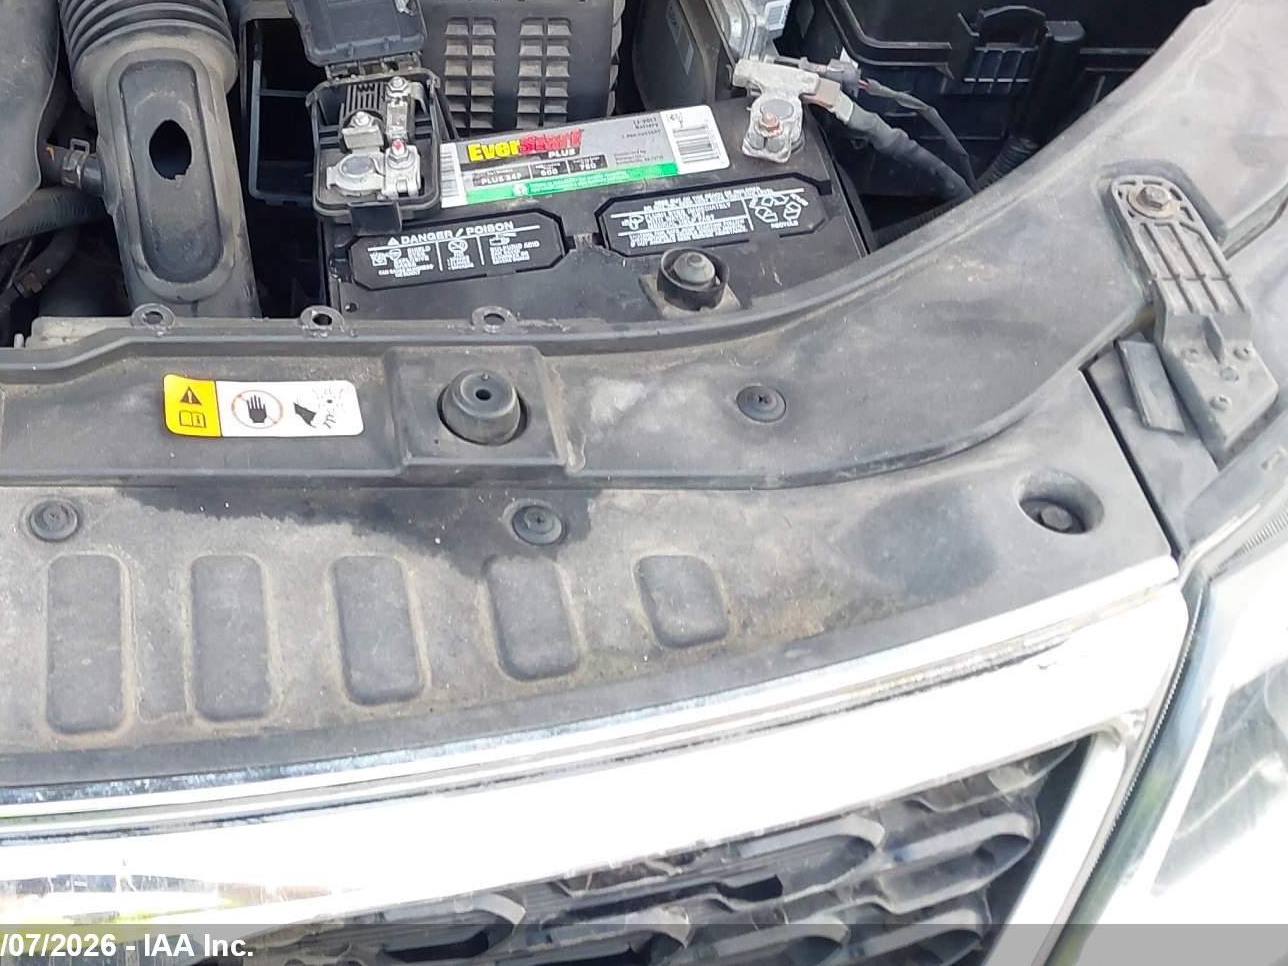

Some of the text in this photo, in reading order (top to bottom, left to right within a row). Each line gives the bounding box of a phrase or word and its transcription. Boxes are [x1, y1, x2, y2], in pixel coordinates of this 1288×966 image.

[467, 128, 582, 162] EverStart
[548, 148, 576, 158] PLUS
[401, 229, 452, 245] DANGER
[466, 221, 514, 236] POISON
